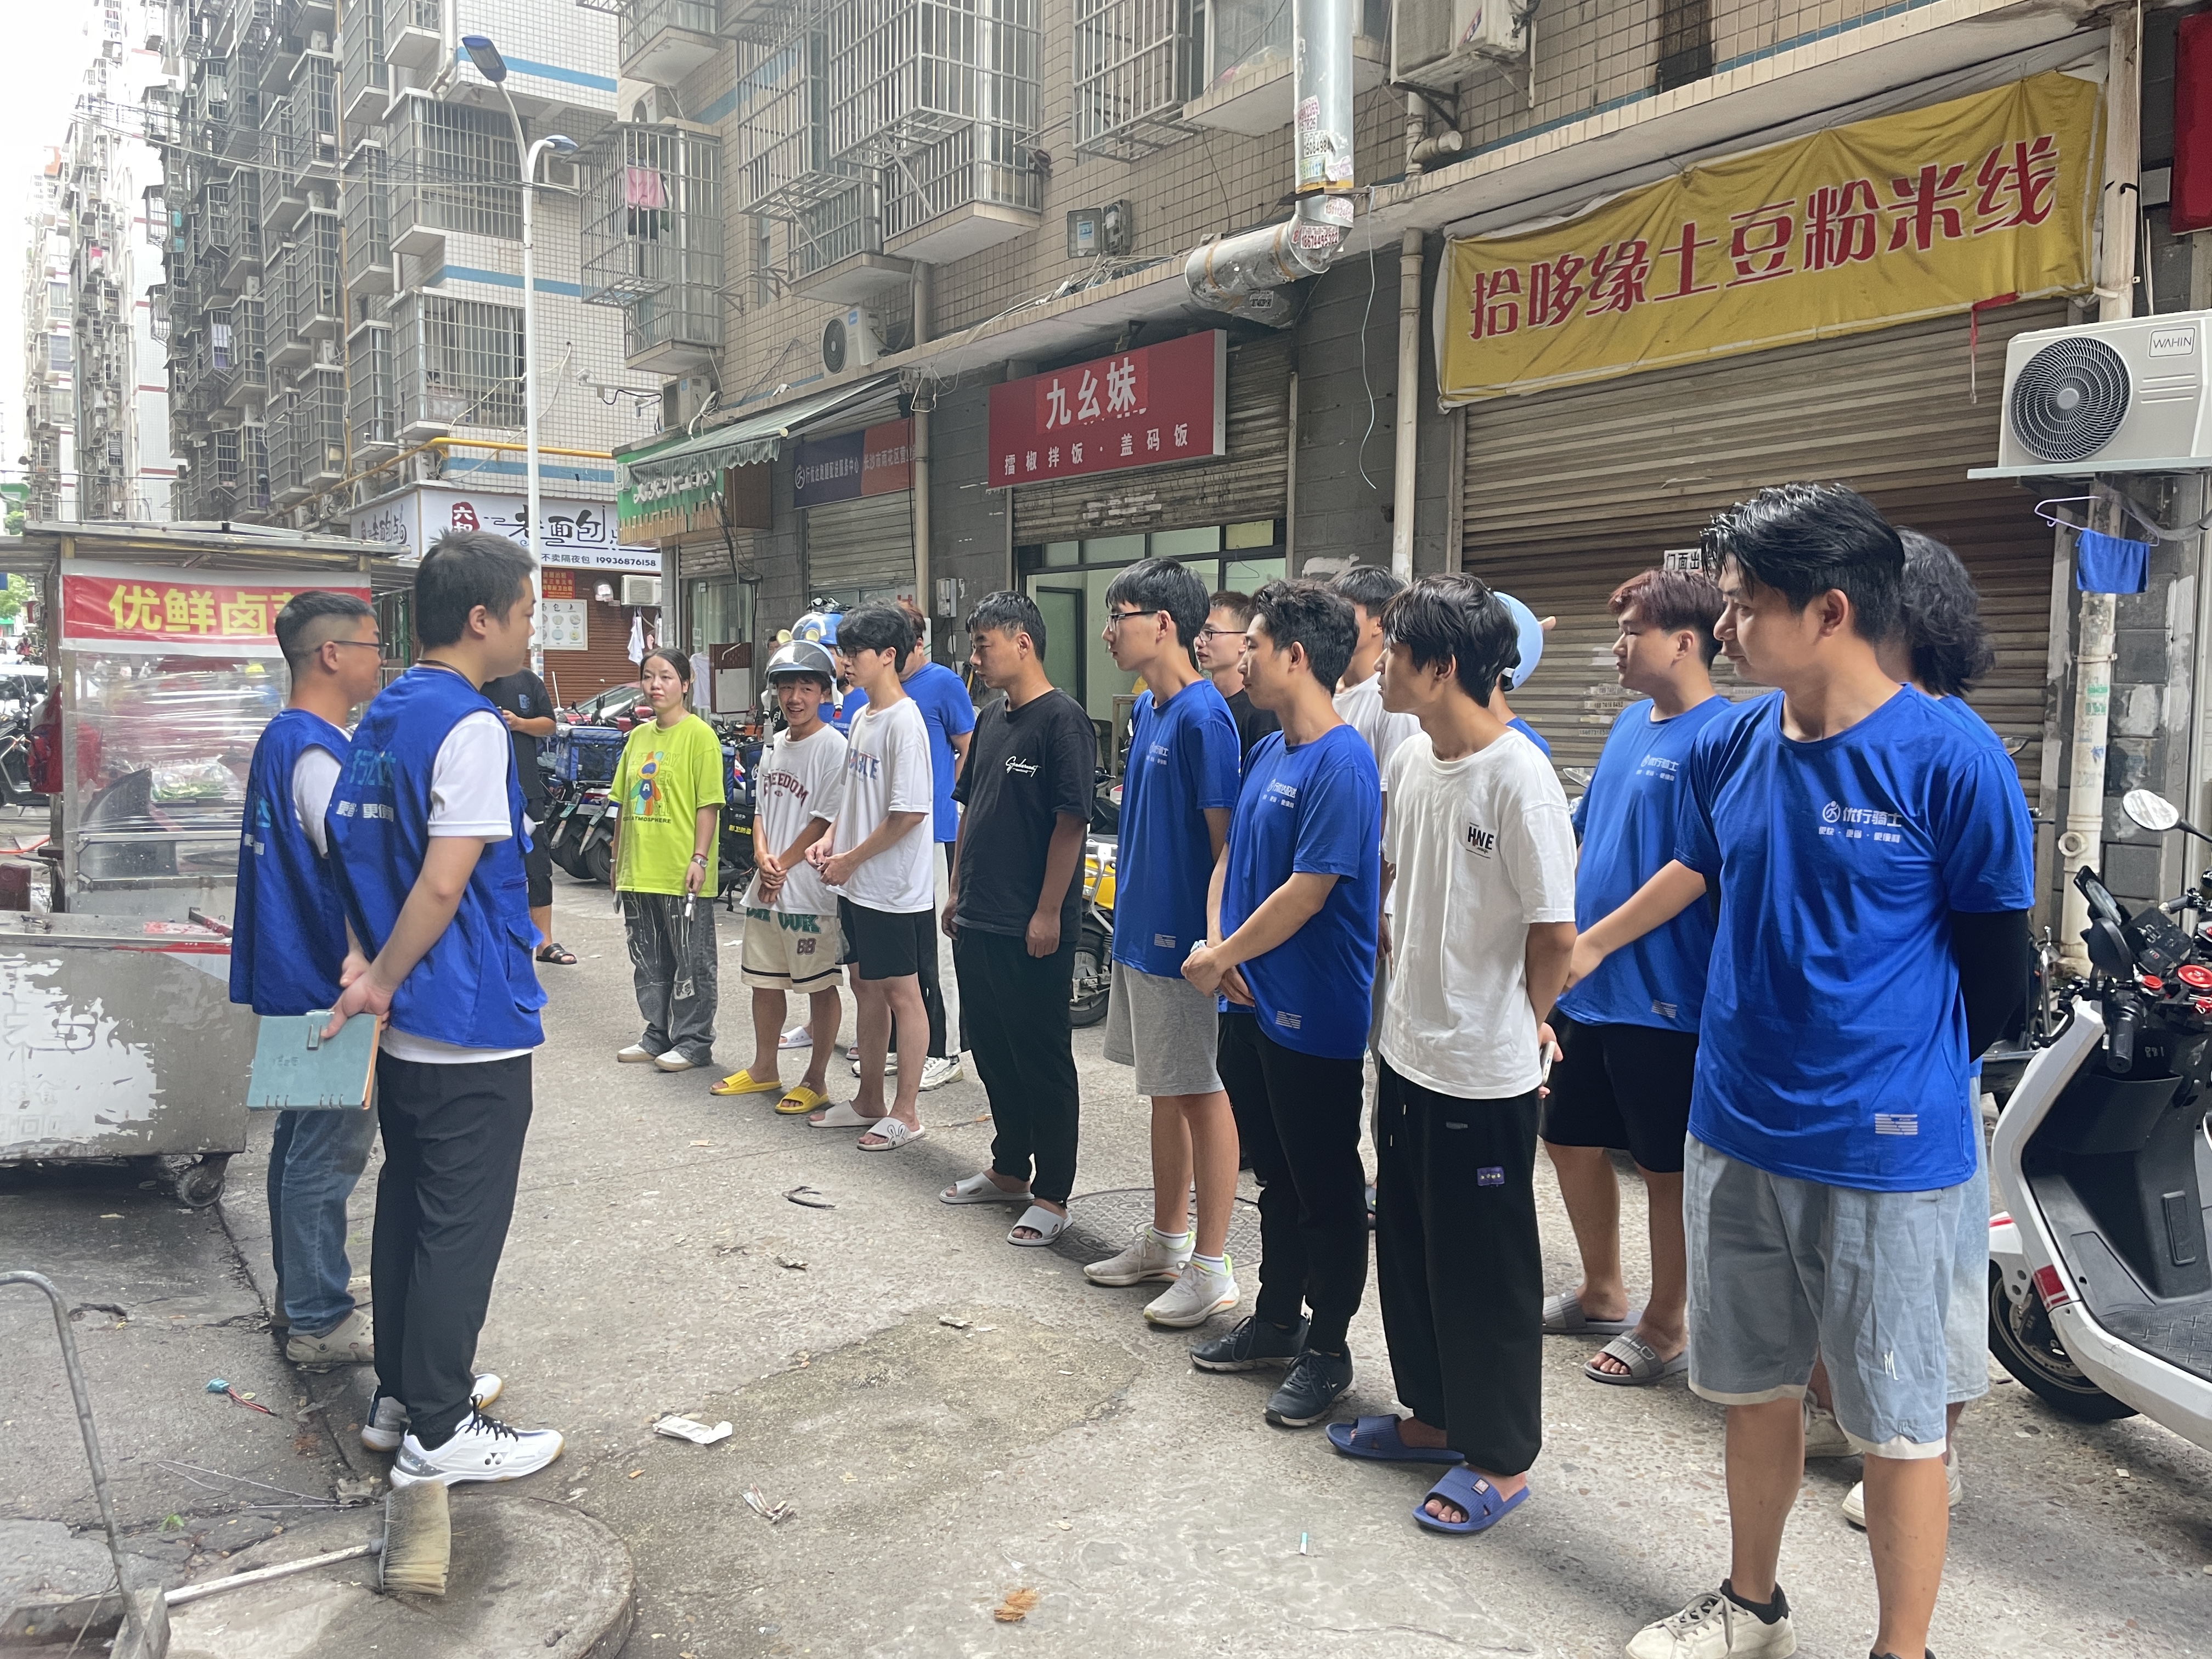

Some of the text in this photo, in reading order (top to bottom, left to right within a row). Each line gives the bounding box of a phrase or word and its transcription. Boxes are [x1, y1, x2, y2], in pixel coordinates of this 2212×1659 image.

[1470, 134, 2059, 341] 拾哆缘土豆粉米线
[2153, 336, 2192, 348] WAHIN
[1046, 357, 1137, 430] 九幺妹
[509, 504, 618, 544] 老面包
[541, 554, 656, 566] 不卖隔夜包 19936876158
[1843, 807, 1903, 827] 优行骑士
